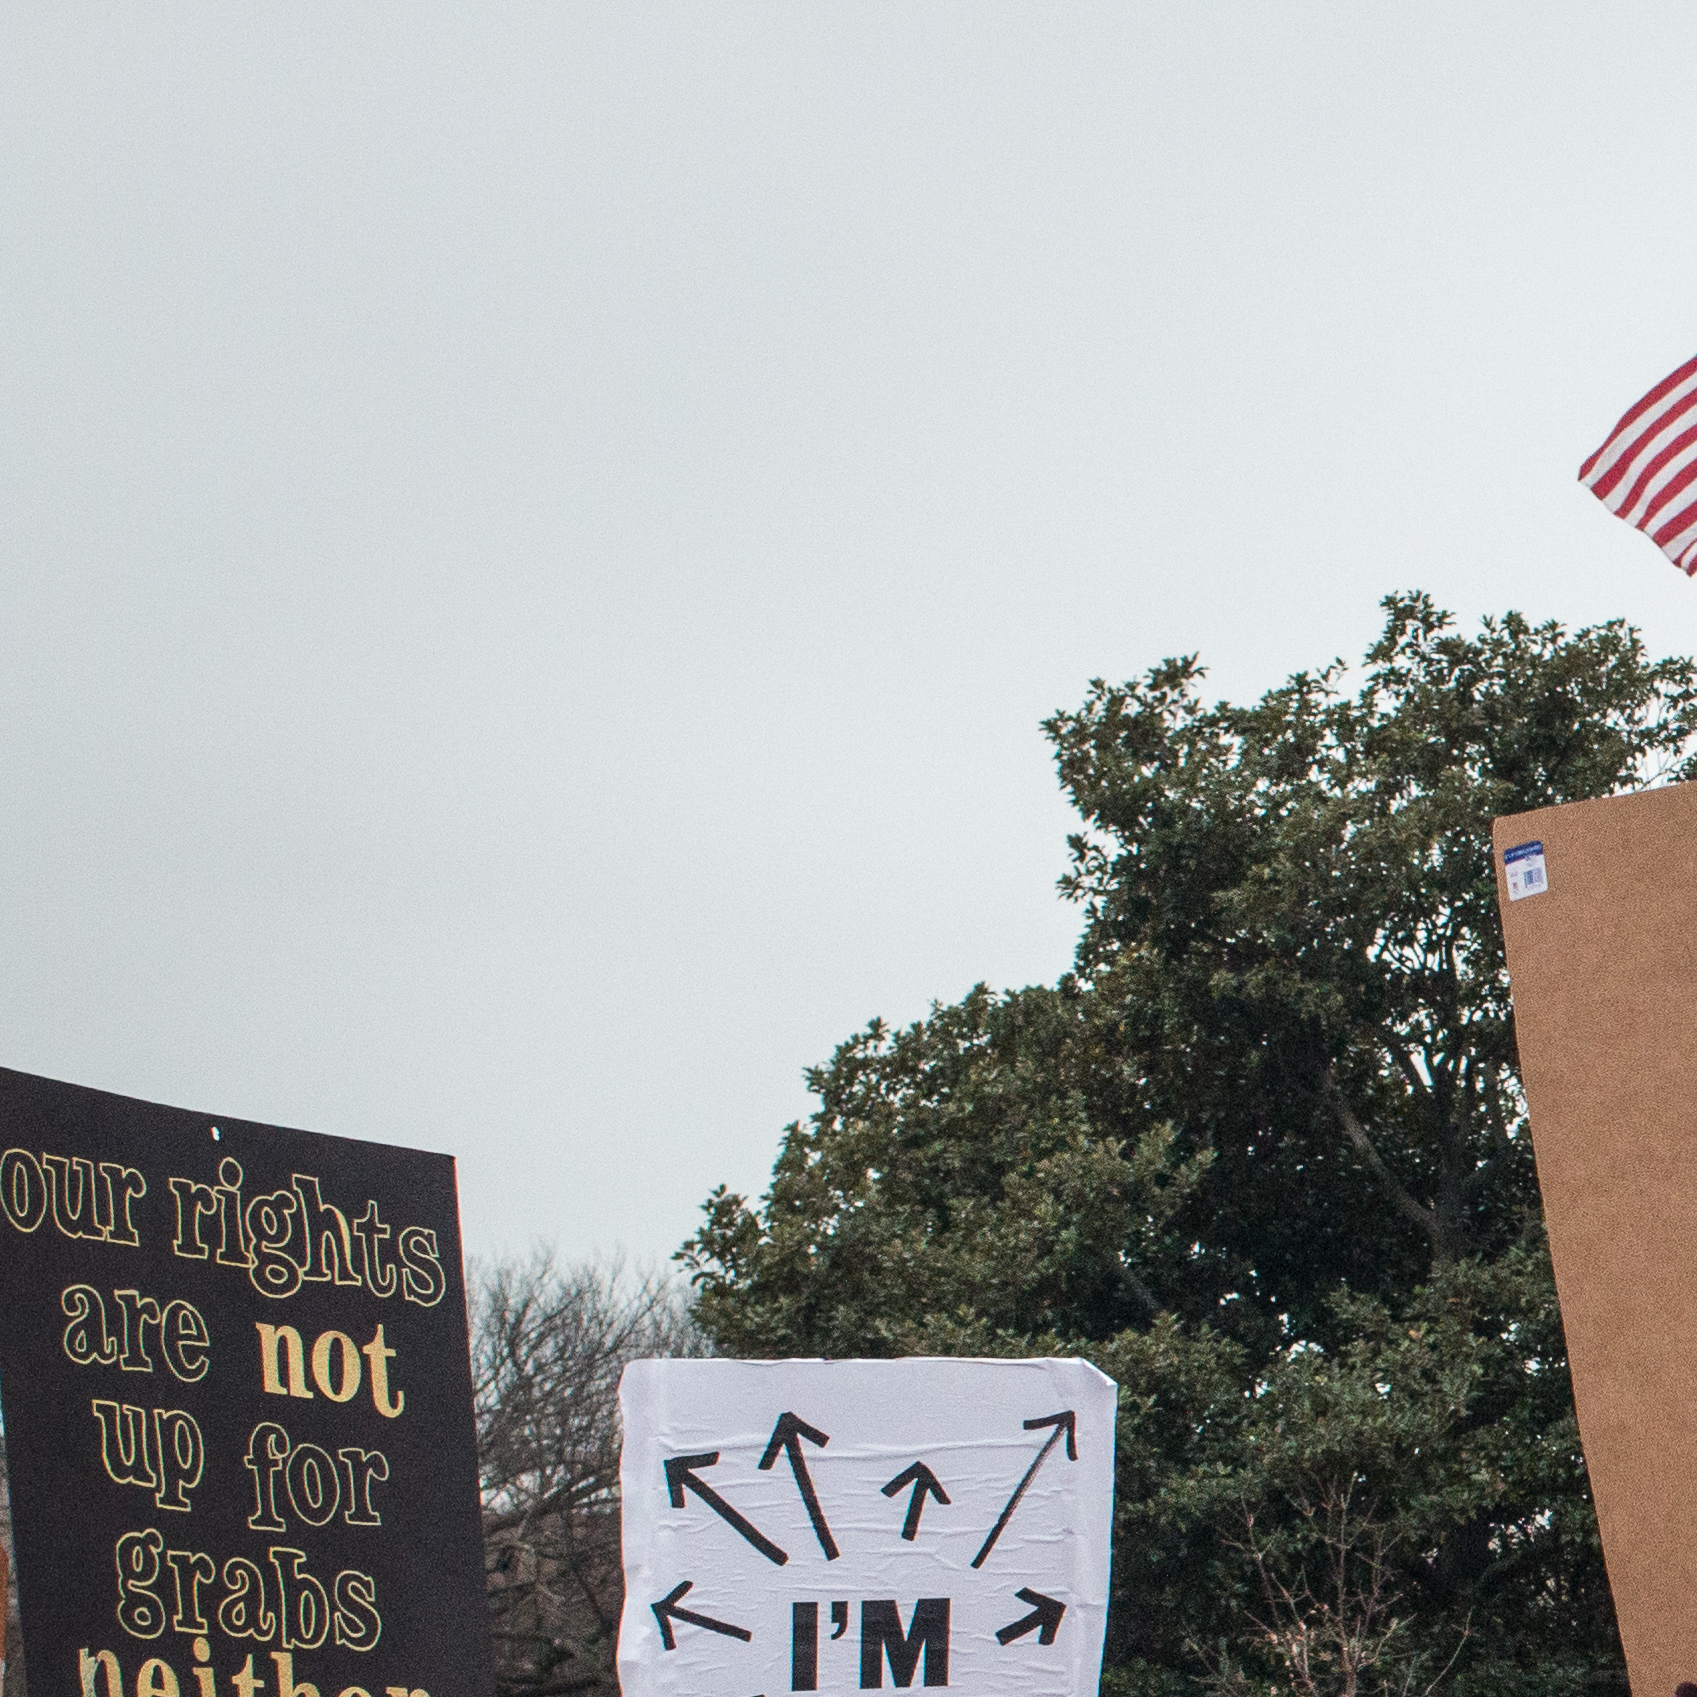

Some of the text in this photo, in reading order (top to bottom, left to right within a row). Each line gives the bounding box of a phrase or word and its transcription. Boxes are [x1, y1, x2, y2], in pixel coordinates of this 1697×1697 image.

[2, 1148, 446, 1306] our rights
[62, 1283, 405, 1418] are not
[93, 1400, 389, 1531] up for
[115, 1528, 382, 1651] grabs
[791, 1597, 951, 1692] I'M
